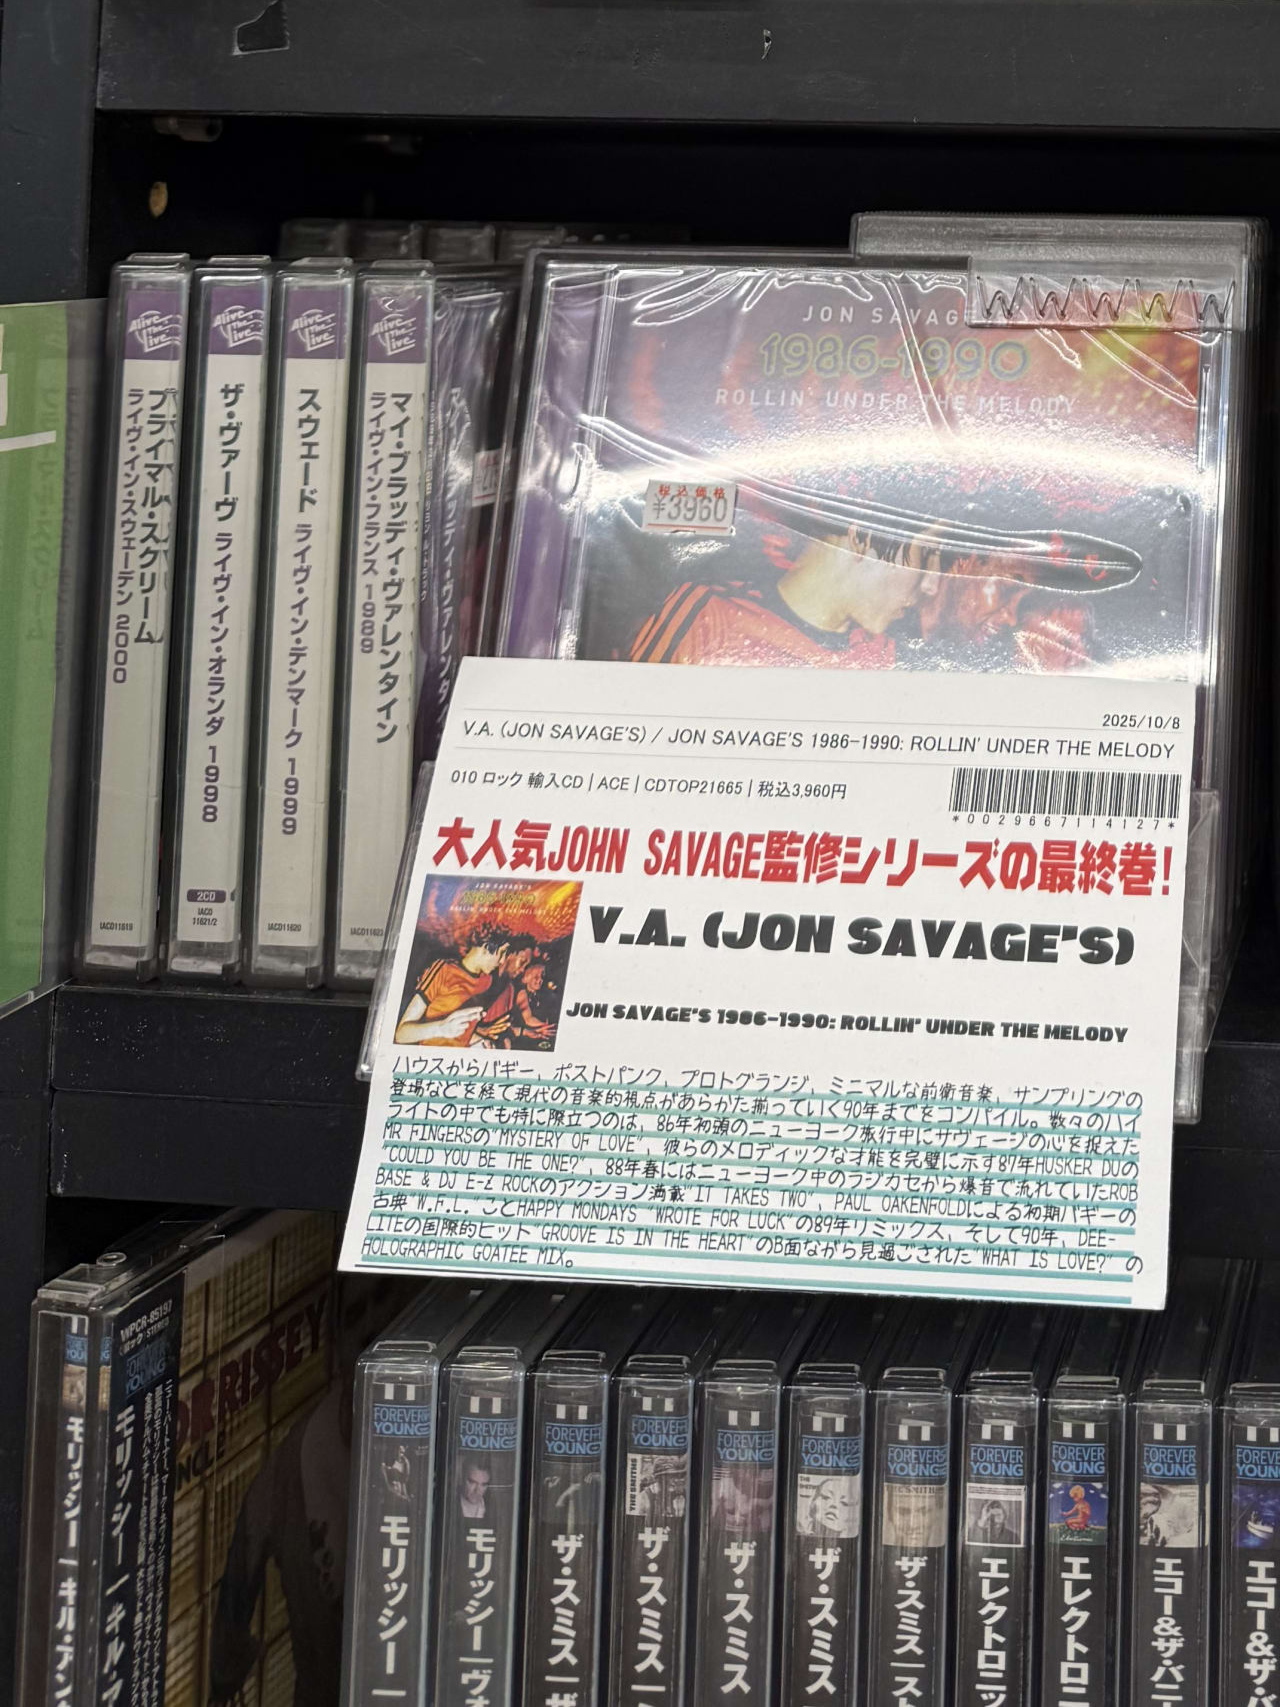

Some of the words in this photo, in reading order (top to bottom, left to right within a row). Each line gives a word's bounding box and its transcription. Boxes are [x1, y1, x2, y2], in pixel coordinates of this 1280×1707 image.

[760, 331, 1030, 382] 1986-1990
[825, 392, 911, 411] UNDER
[922, 393, 970, 412] THE
[978, 395, 1076, 415] MELODY
[214, 383, 246, 522] ザ・ヴァーヴ
[297, 388, 322, 514] スウェード
[134, 388, 170, 644] プライマル・スクリーム
[653, 496, 728, 524] ¥3960
[376, 391, 414, 744] マイ・ブラッディ・ヴァレンタイン
[112, 613, 131, 684] 2000
[205, 531, 233, 737] ライヴ・イン・オランダ
[284, 523, 312, 750] ライヴ・イン・デンマーク
[360, 583, 376, 654] 1989
[669, 729, 705, 744] JON
[713, 730, 802, 747] SAVAGE'S
[813, 734, 902, 750] 1986-1990:
[911, 736, 980, 752] ROLLIN'
[987, 738, 1049, 754] UNDER
[1057, 740, 1091, 755] THE
[1099, 742, 1174, 758] MELODY
[1103, 714, 1179, 729] 2025/10/8
[202, 745, 220, 823] 1998
[282, 757, 299, 835] 1999
[597, 777, 629, 790] ACE
[645, 779, 743, 794] CDTOP21665
[433, 818, 628, 873] 大人気JOHN
[590, 906, 686, 947] V.A.
[703, 912, 835, 953] (JON
[848, 919, 1134, 965] SAVAGE'S)
[361, 1237, 464, 1261] HOLOGRAPHIC
[473, 1246, 528, 1265] GOATEE
[63, 1415, 85, 1548] モリッシー
[970, 1447, 1023, 1463] FOREVER
[970, 1462, 1023, 1476] YOUNG
[380, 1515, 411, 1675] モリッシー
[548, 1534, 583, 1666] ザ・スミス
[893, 1556, 927, 1656] ザ・スミス
